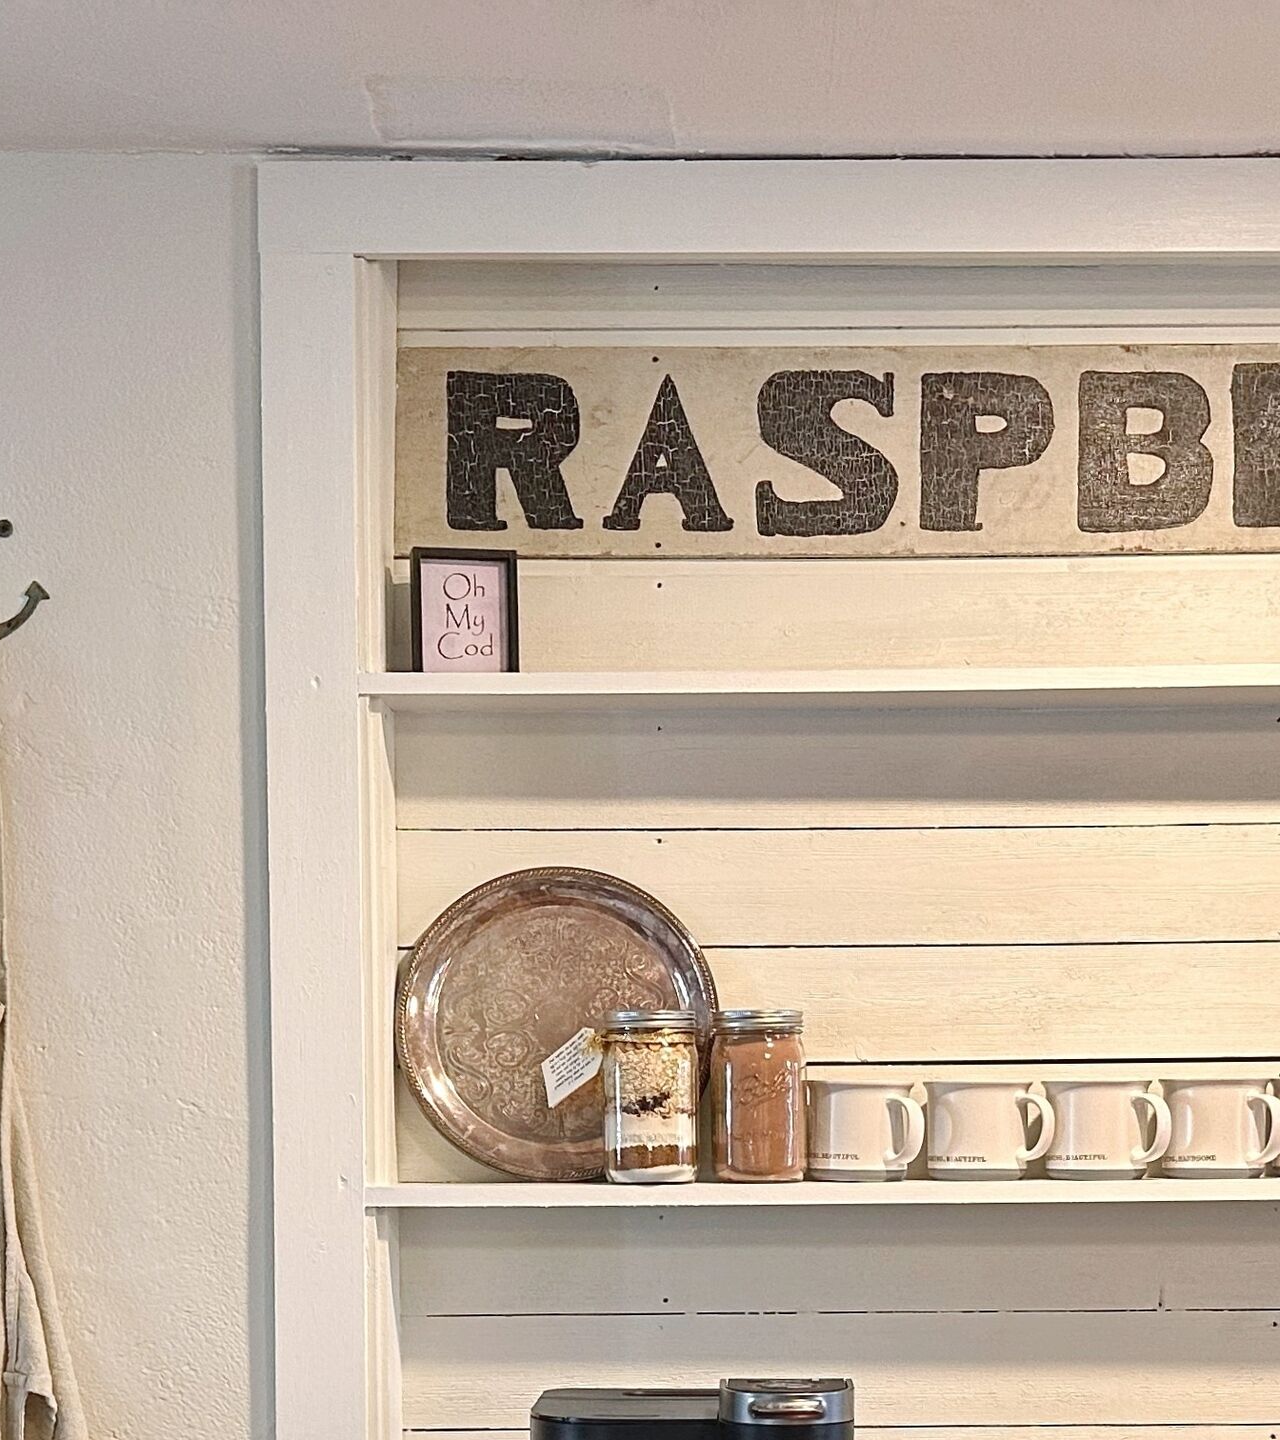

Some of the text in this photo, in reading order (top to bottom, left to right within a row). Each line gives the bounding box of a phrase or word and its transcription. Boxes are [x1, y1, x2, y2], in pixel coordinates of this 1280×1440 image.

[443, 573, 485, 600] Oh
[446, 603, 485, 636] My
[438, 632, 493, 659] Cod
